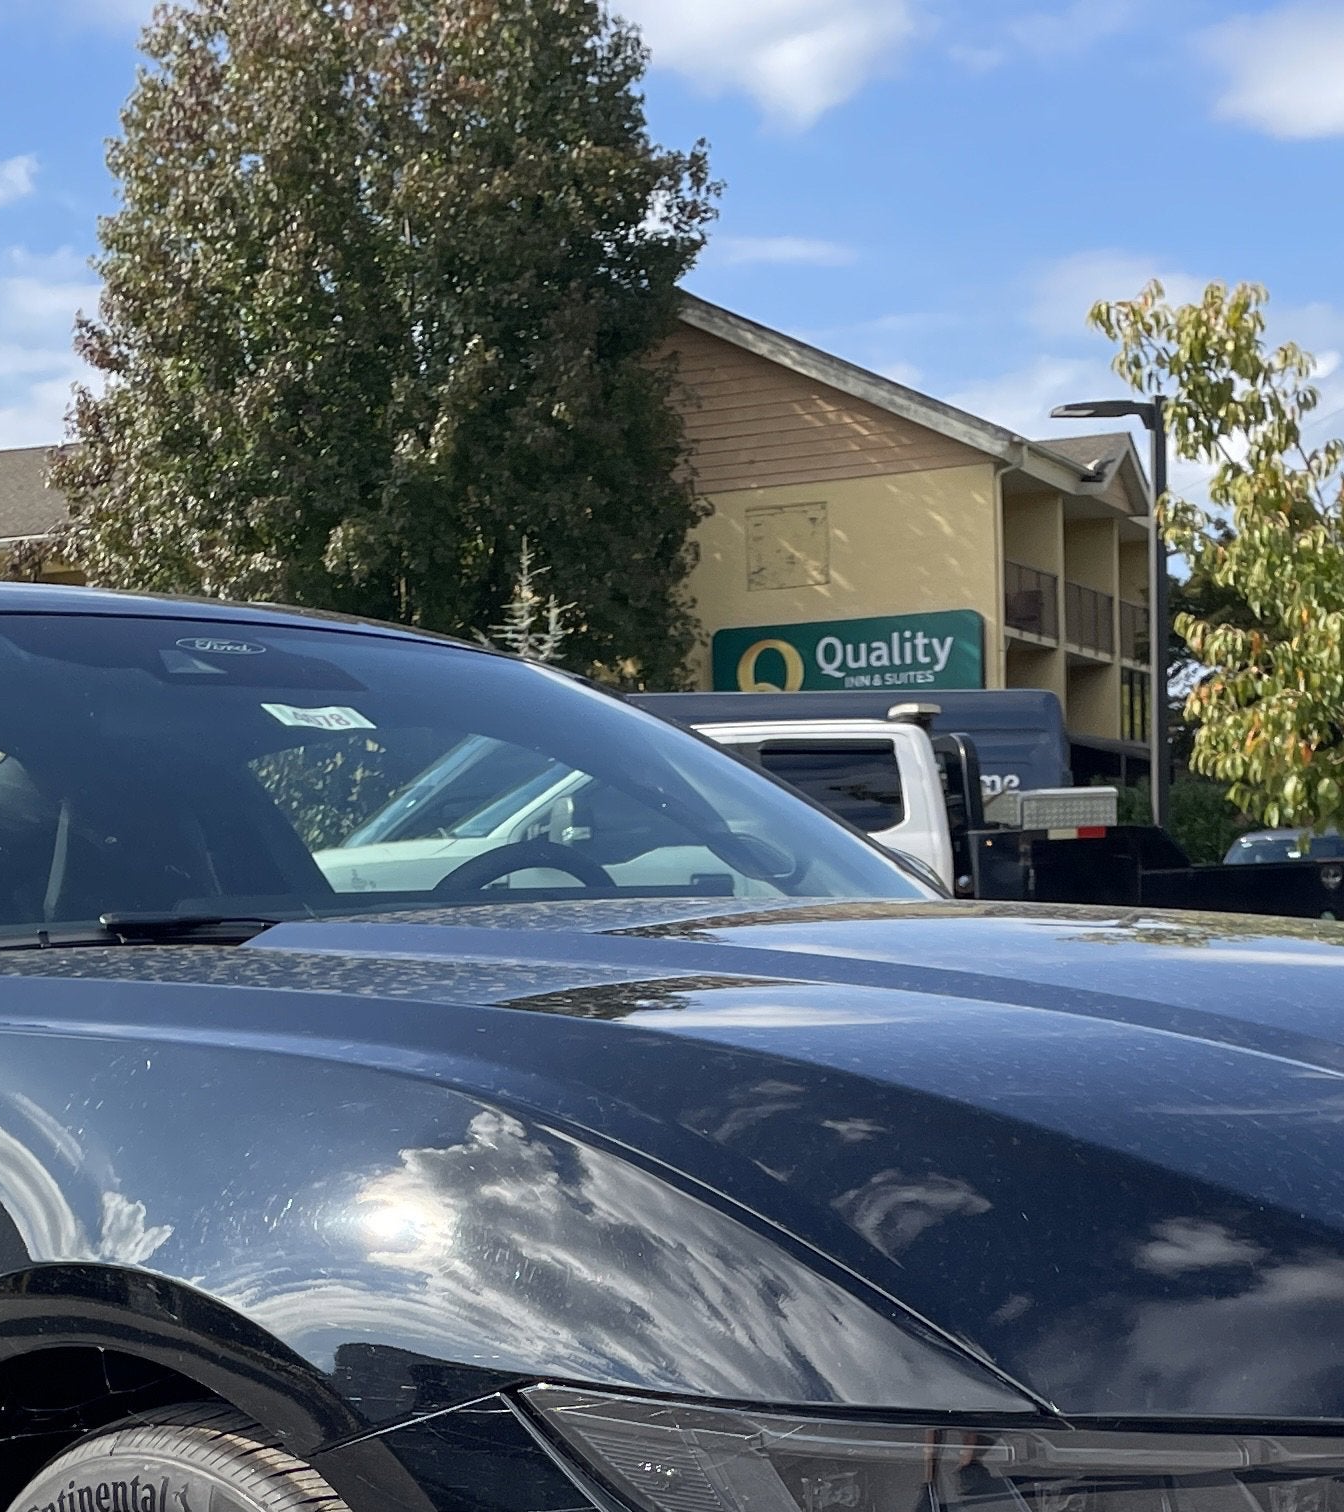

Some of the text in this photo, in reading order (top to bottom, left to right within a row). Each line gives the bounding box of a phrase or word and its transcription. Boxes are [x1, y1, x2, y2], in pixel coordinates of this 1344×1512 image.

[195, 640, 252, 653] Ford
[816, 630, 954, 678] Quality
[845, 670, 935, 688] INN & SUITES
